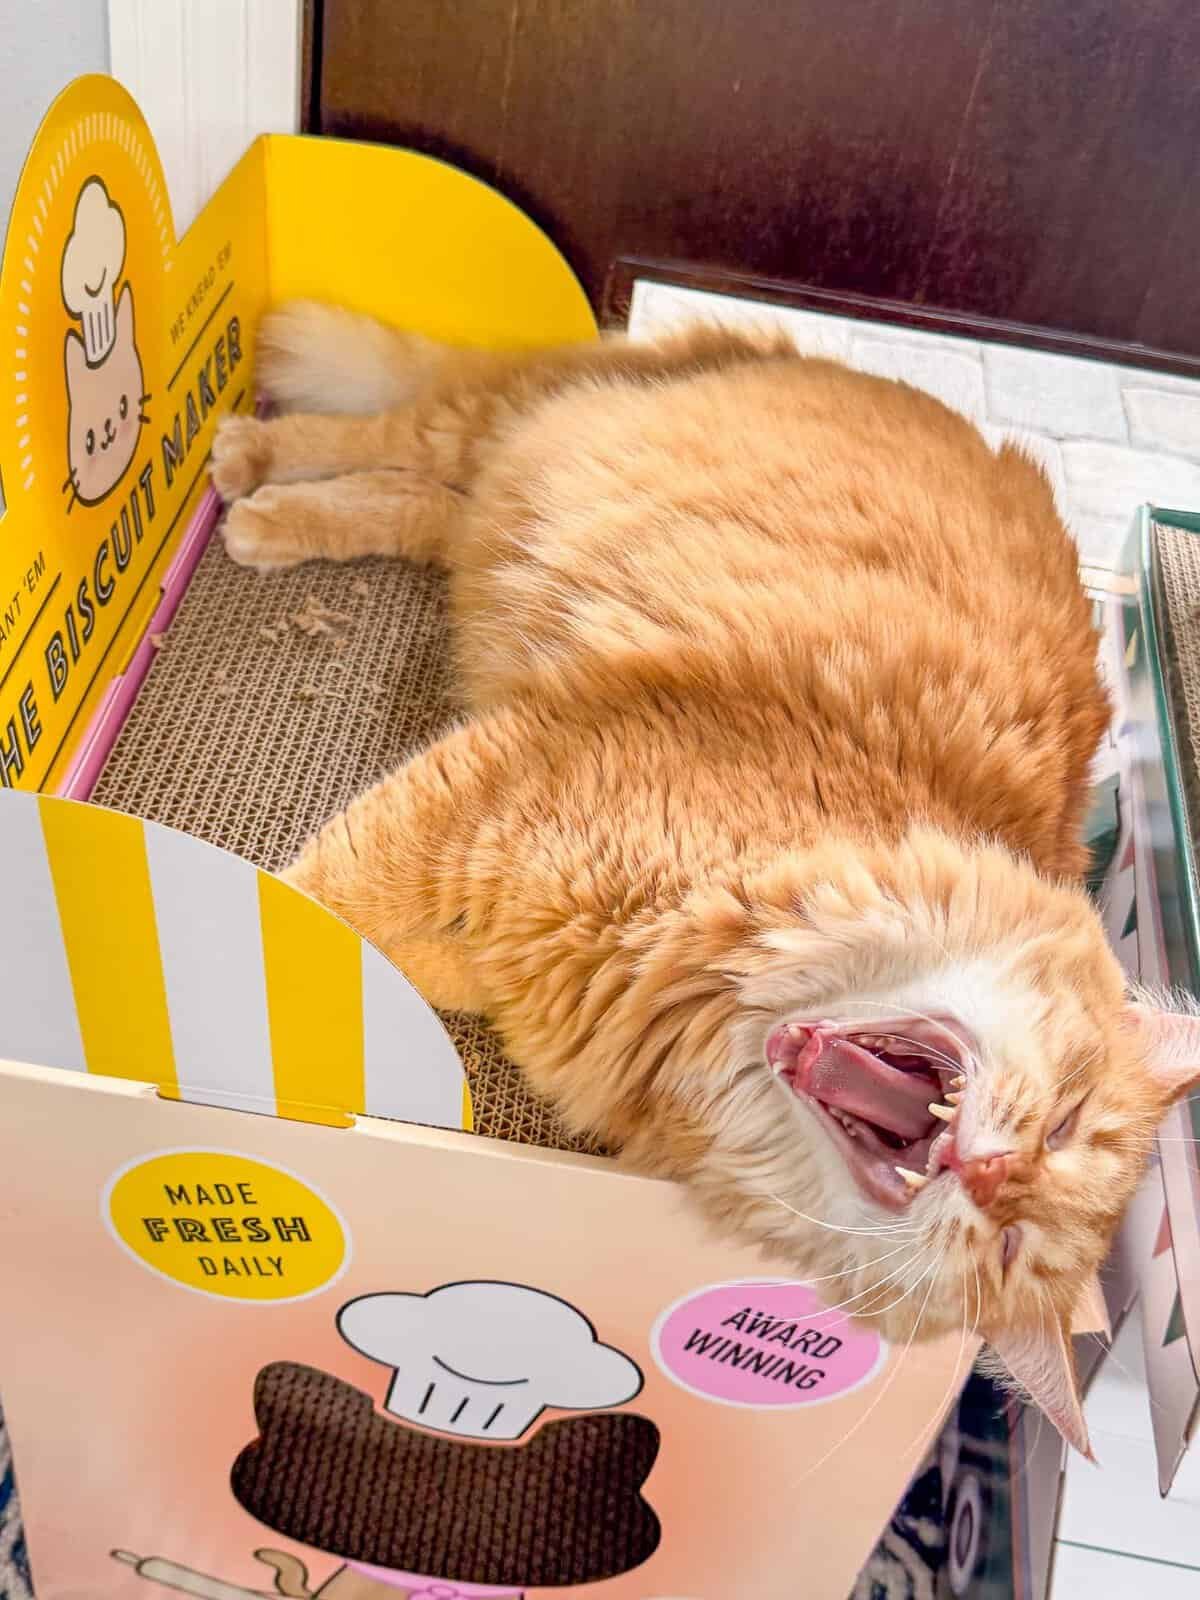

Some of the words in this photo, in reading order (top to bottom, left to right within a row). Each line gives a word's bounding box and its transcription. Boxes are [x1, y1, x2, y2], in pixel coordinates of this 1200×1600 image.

[45, 457, 155, 703] BISCUIT
[162, 316, 243, 488] MAKER
[23, 551, 46, 593] 'EM
[164, 1182, 258, 1206] MADE
[142, 1216, 313, 1243] FRESH
[198, 1255, 285, 1277] DAILY
[720, 1307, 844, 1360] AWARD
[683, 1328, 826, 1390] WINNING
